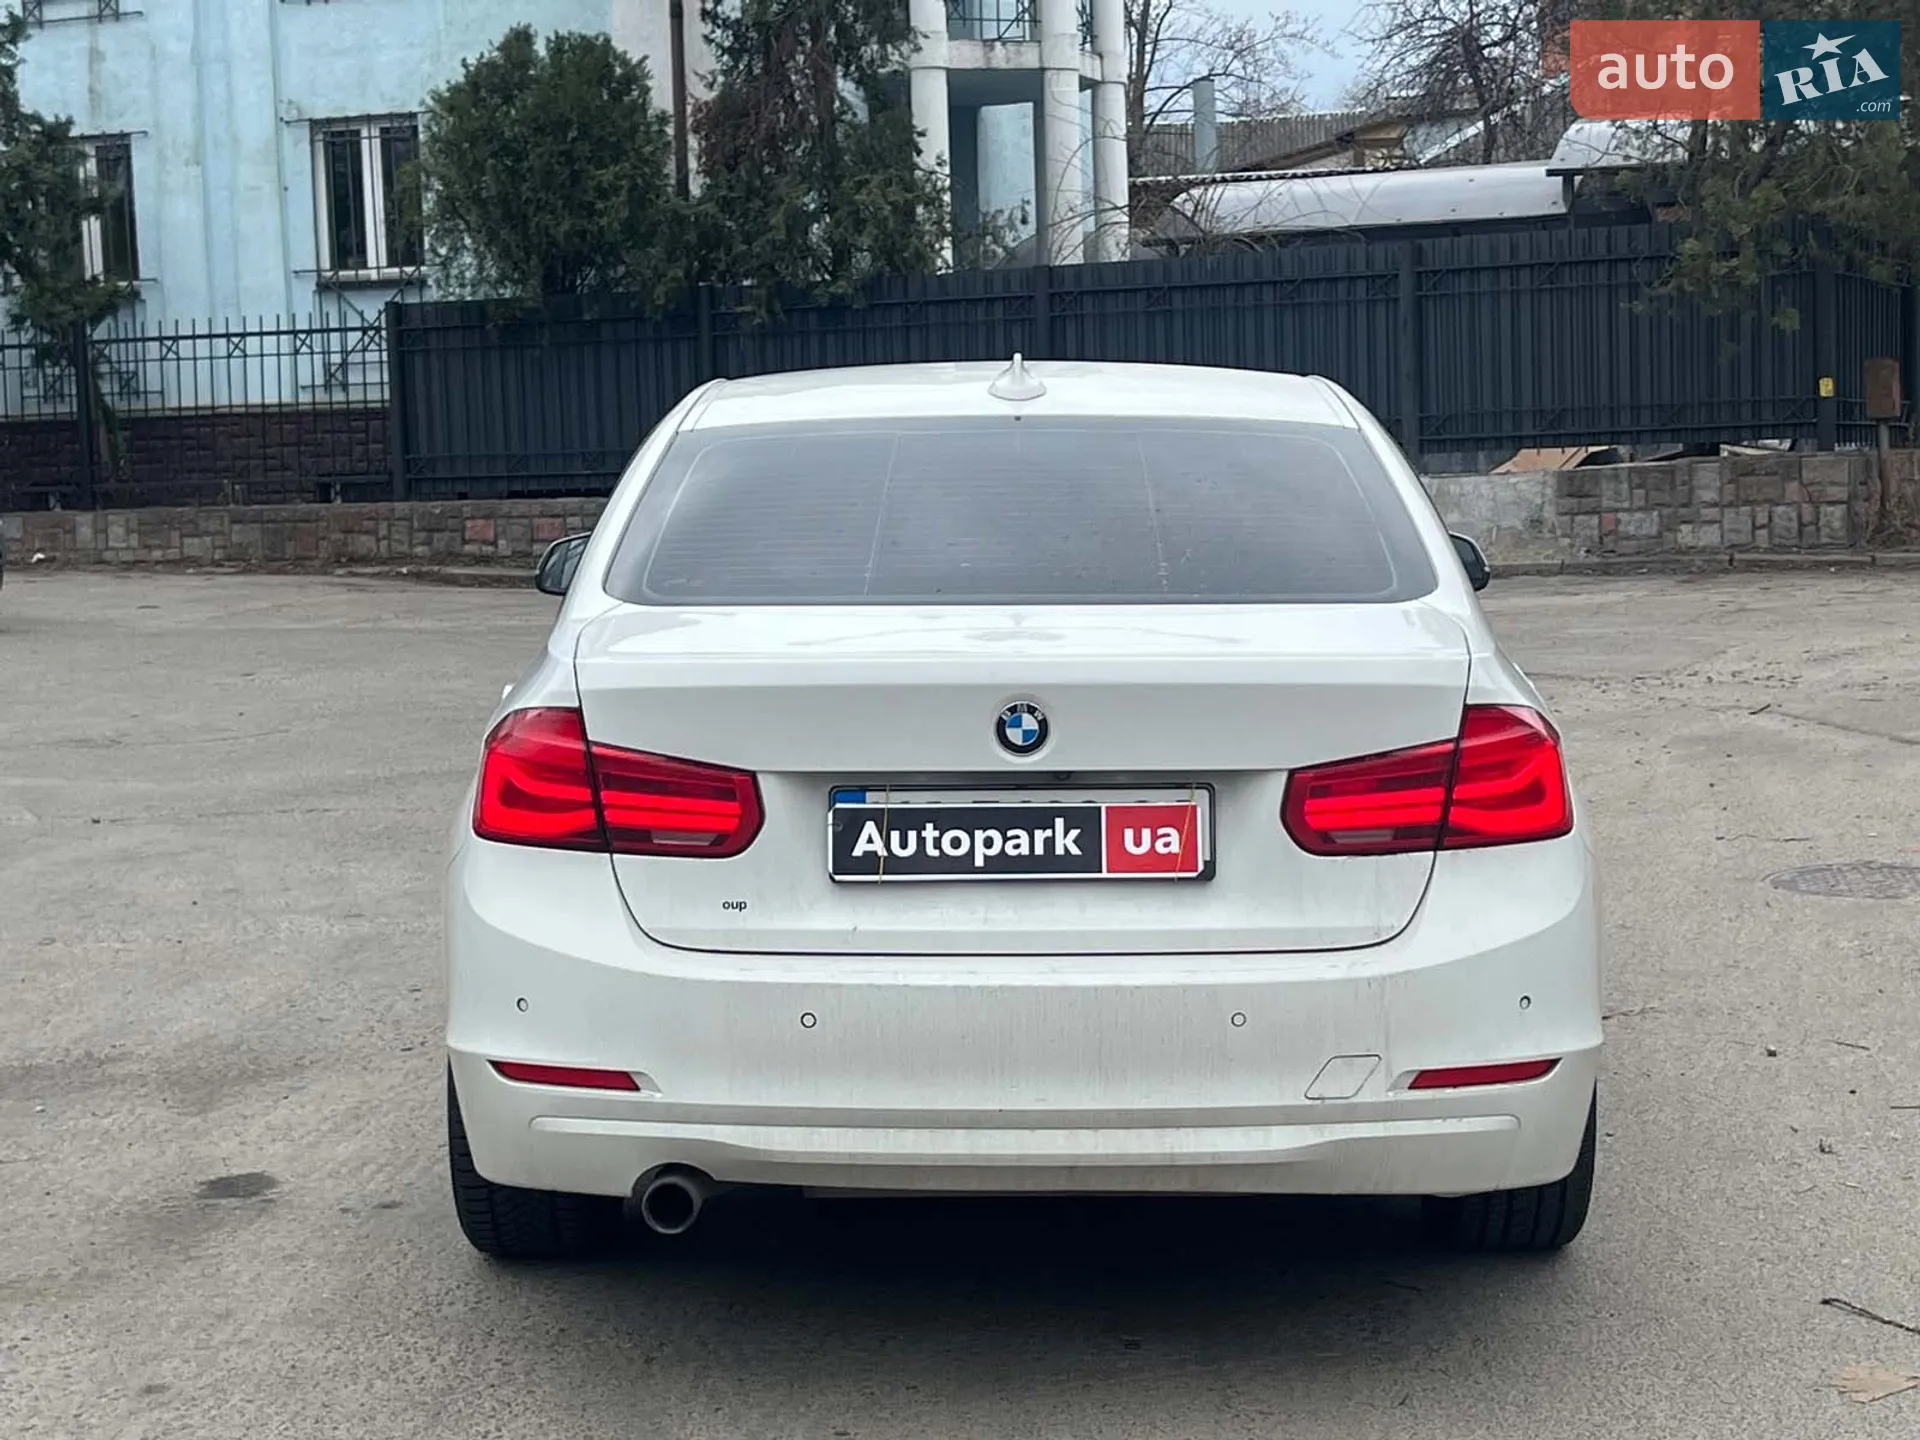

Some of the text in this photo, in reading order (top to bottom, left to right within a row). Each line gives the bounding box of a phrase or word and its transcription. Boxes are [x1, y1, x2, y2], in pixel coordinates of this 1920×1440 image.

[851, 817, 1182, 867] Autopark ua
[722, 901, 748, 913] oup
